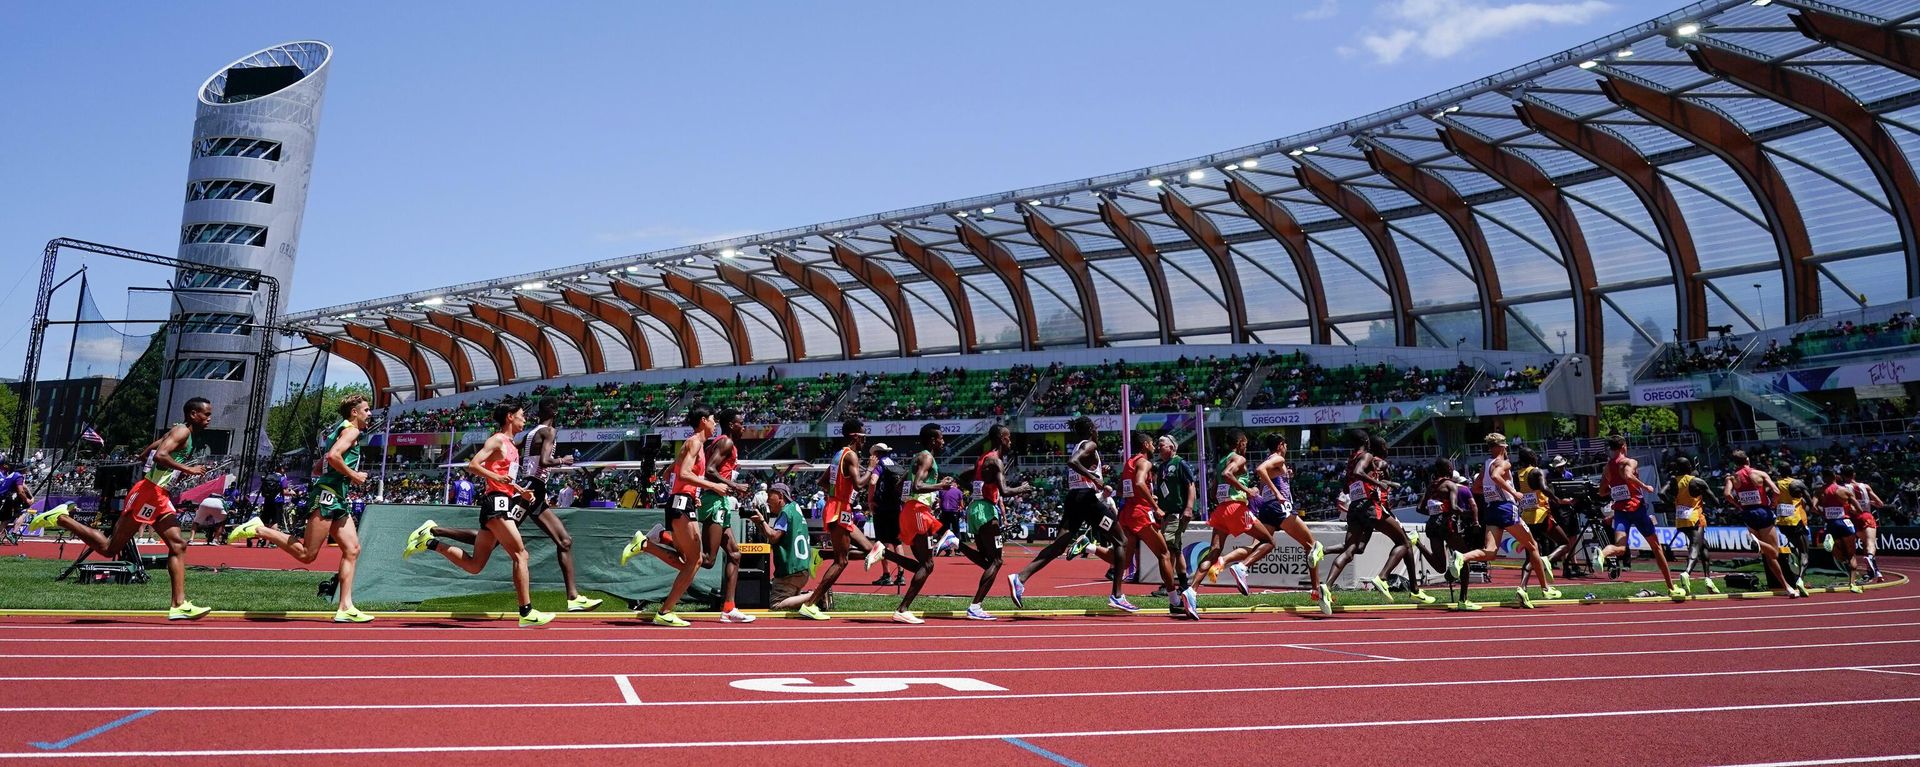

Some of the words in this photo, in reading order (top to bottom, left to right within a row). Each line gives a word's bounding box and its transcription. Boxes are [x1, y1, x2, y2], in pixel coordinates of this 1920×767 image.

[1251, 415, 1300, 424] OREGON22
[1033, 423, 1071, 431] OREGON2
[322, 493, 333, 502] 10
[499, 499, 506, 508] 8
[678, 498, 683, 507] 1
[141, 507, 154, 518] 18
[512, 507, 524, 519] 16
[841, 513, 852, 522] 22
[1102, 517, 1110, 527] 17
[1881, 533, 1920, 550] Maso
[1246, 562, 1308, 575] EGON22
